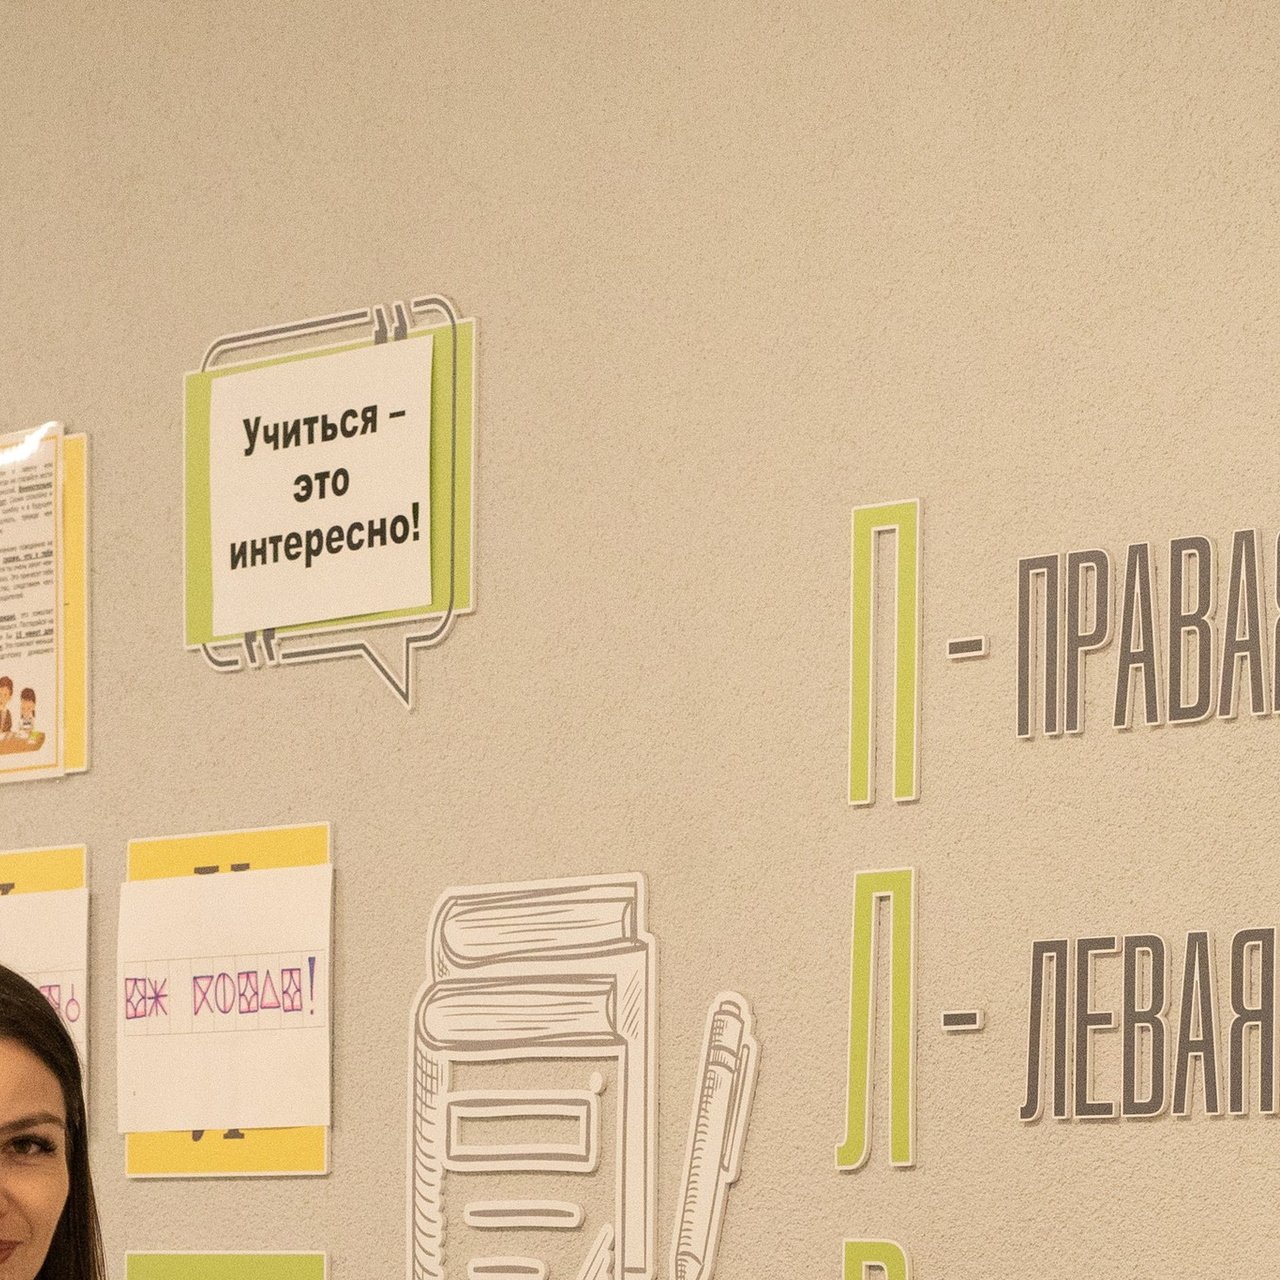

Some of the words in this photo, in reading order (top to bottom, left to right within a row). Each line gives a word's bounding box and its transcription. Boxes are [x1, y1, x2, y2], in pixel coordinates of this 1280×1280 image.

[243, 405, 377, 456] Учиться
[293, 468, 349, 503] это
[230, 502, 419, 570] интересно!
[849, 499, 920, 804] П
[1016, 528, 1280, 738] ПРАВА
[836, 866, 916, 1170] Л
[1020, 927, 1277, 1121] ЛЕВАЯ
